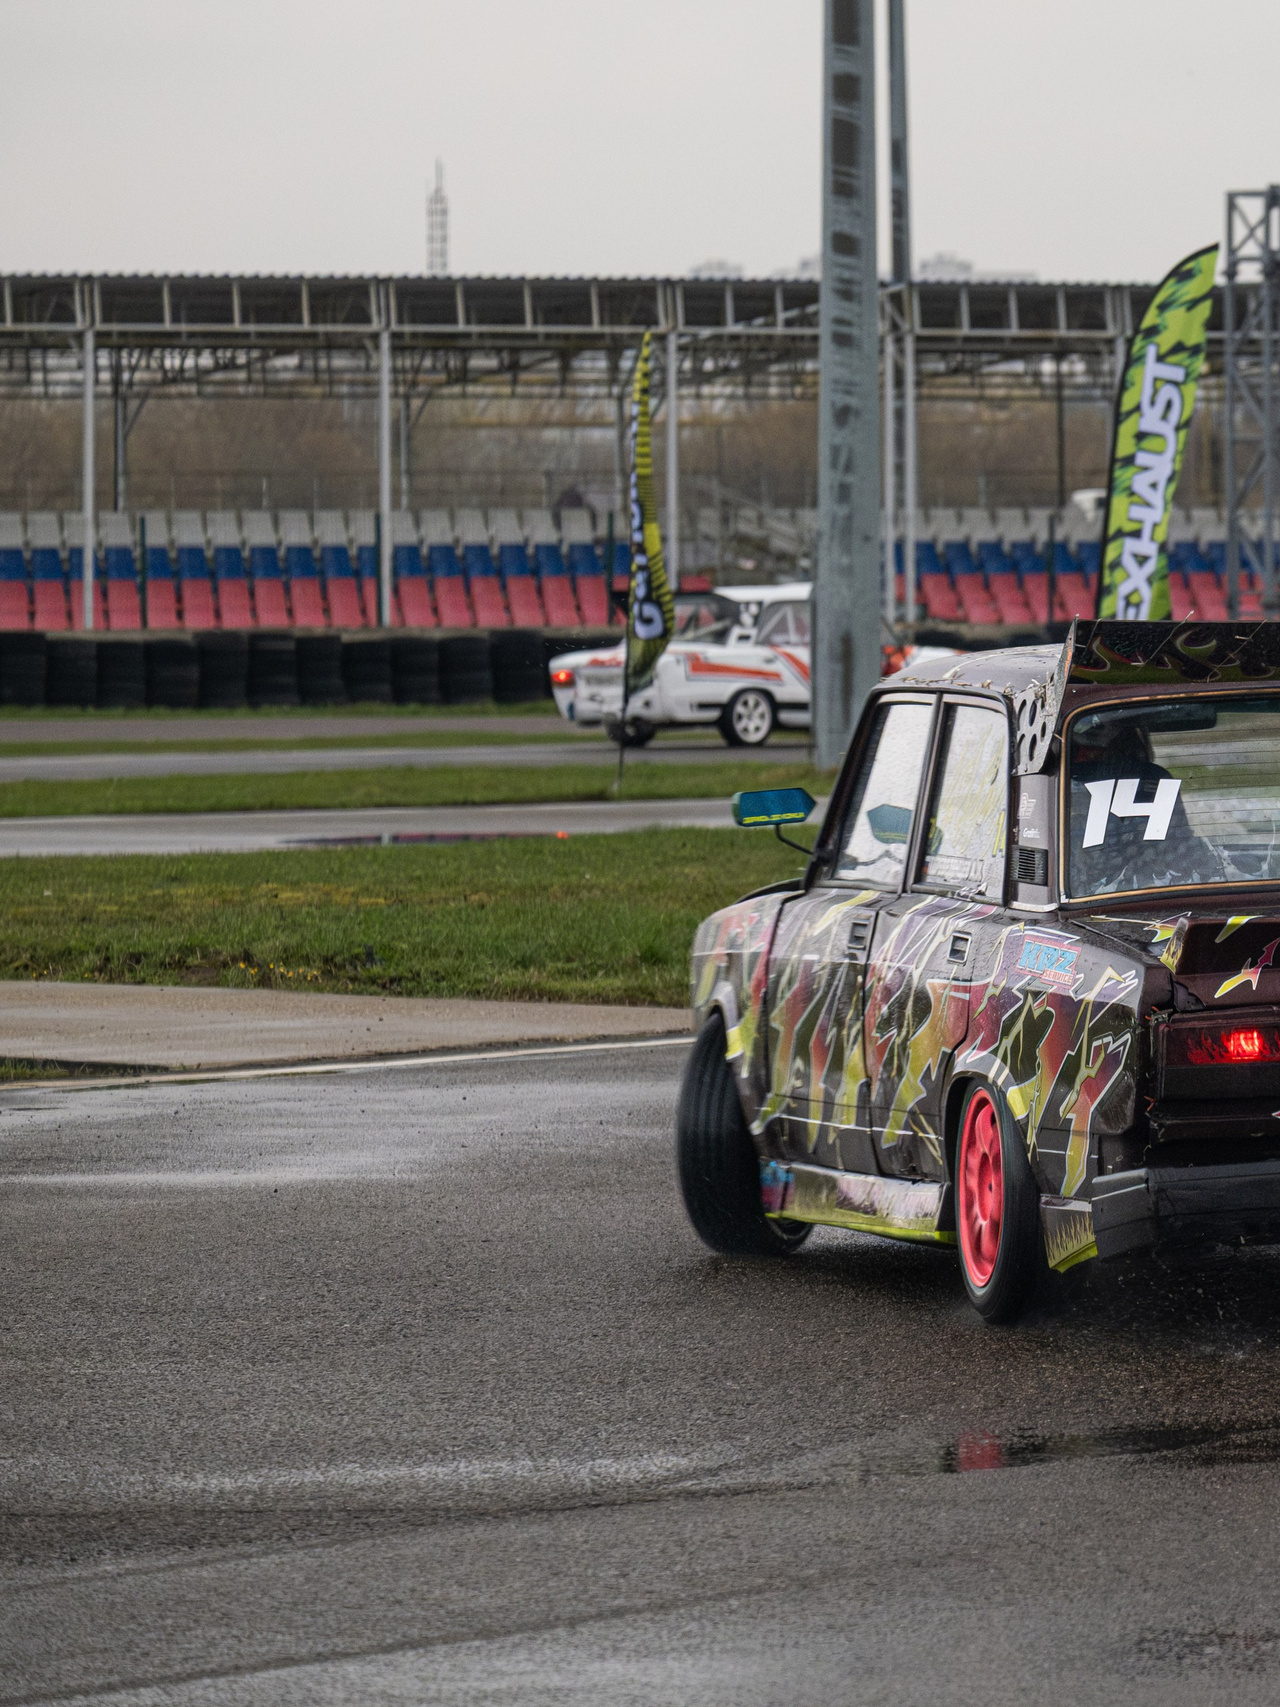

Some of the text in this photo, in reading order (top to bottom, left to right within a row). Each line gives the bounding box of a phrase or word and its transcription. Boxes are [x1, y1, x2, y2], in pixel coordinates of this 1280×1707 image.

[1082, 778, 1181, 848] 14
[1017, 940, 1078, 975] KRZ
[1043, 968, 1074, 984] SERVICE
